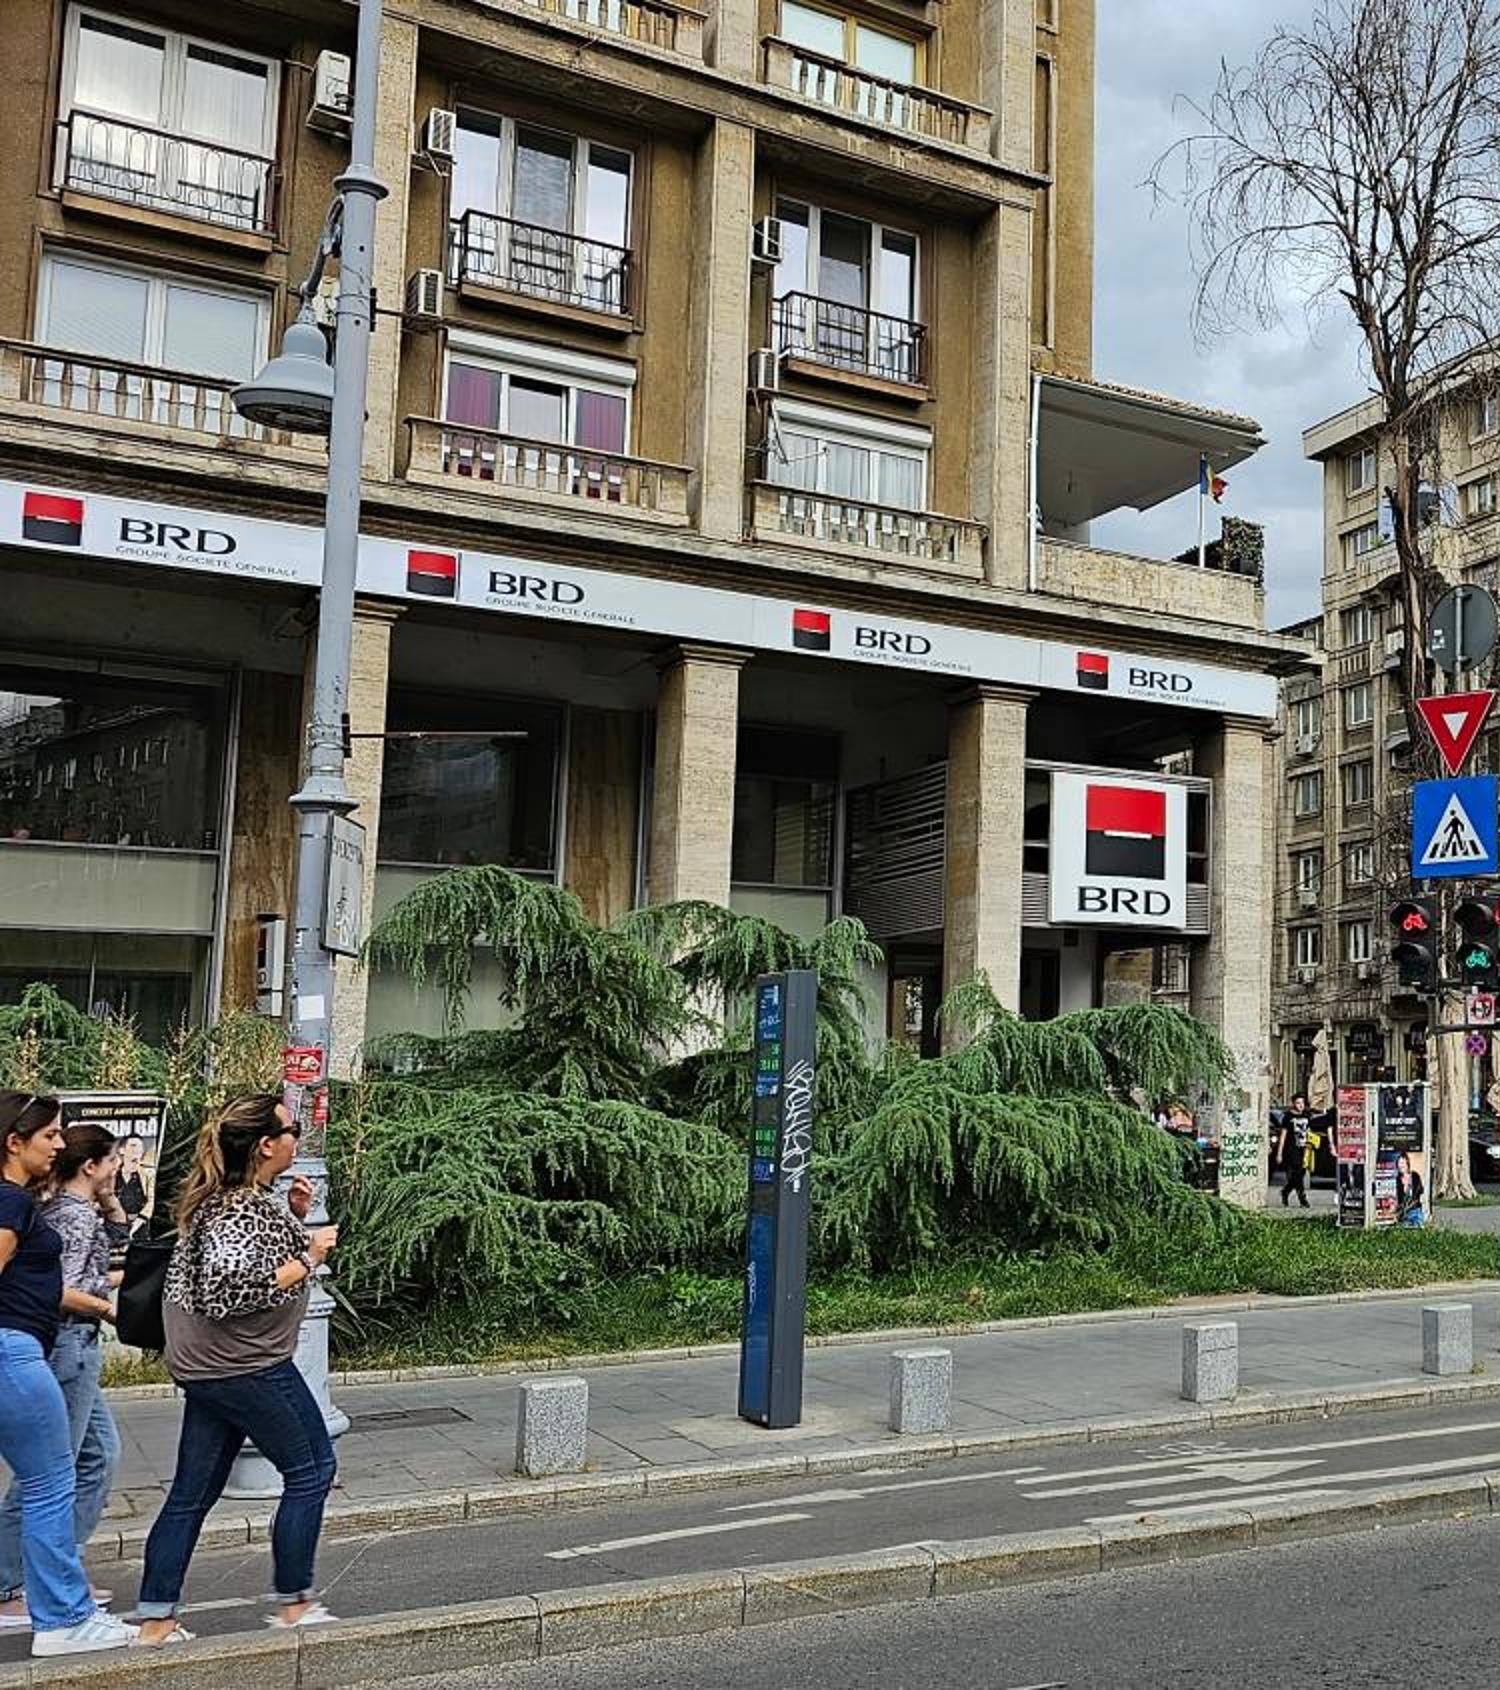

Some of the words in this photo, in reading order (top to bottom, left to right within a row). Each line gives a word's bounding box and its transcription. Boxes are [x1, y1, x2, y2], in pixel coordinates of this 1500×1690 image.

[119, 517, 237, 555] BRD
[115, 545, 170, 560] GROUPE
[488, 571, 585, 604] BRD
[855, 627, 931, 655] BRD
[1129, 668, 1193, 692] BRD
[1077, 886, 1171, 916] BRD
